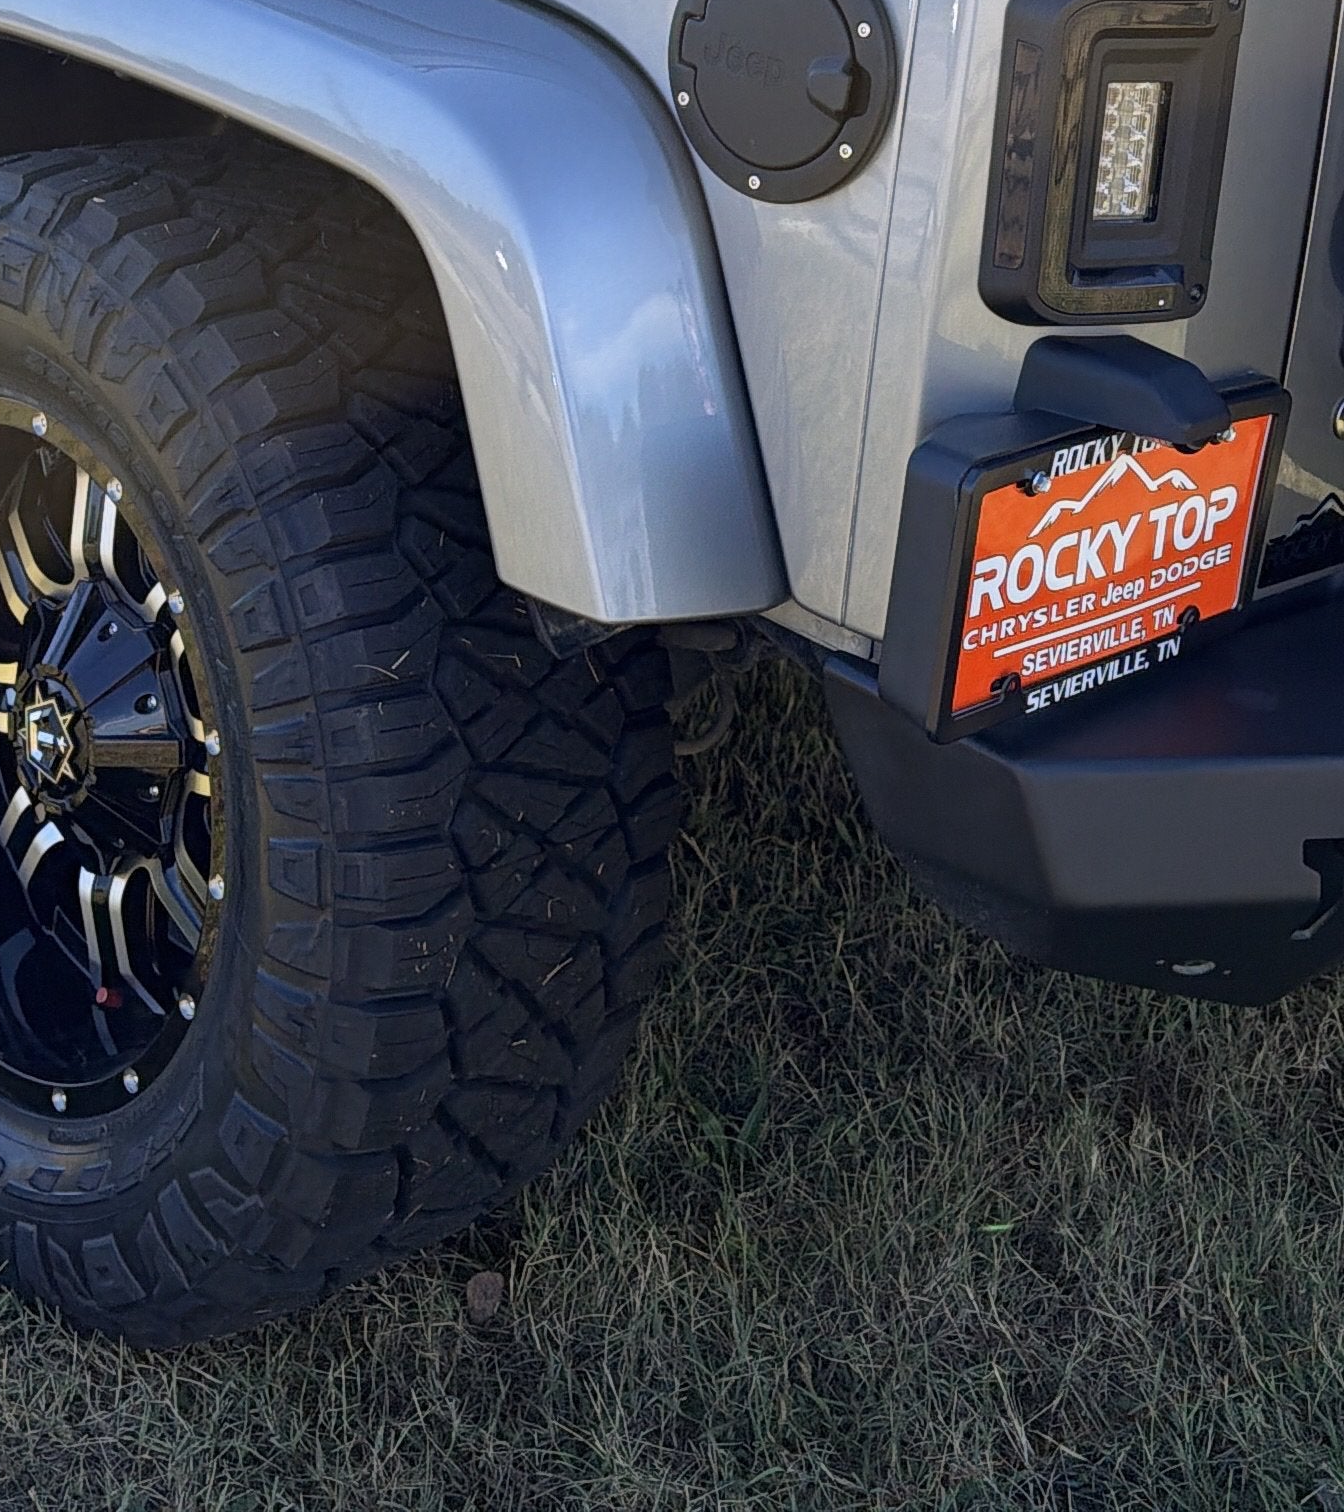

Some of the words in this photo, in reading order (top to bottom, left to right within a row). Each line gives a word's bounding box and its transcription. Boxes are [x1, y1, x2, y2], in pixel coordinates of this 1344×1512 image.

[1050, 432, 1126, 479] ROCKY
[968, 513, 1143, 618] ROCKY
[1148, 485, 1238, 561] TOP
[961, 591, 1097, 651] CHRYSLER
[1101, 577, 1145, 607] Jeep
[1149, 542, 1232, 590] DODGE
[1021, 616, 1147, 677] SEVIERVILLE,
[1153, 603, 1176, 631] TN
[1025, 648, 1150, 714] SEVIERVILLE,
[1157, 635, 1181, 662] TN
